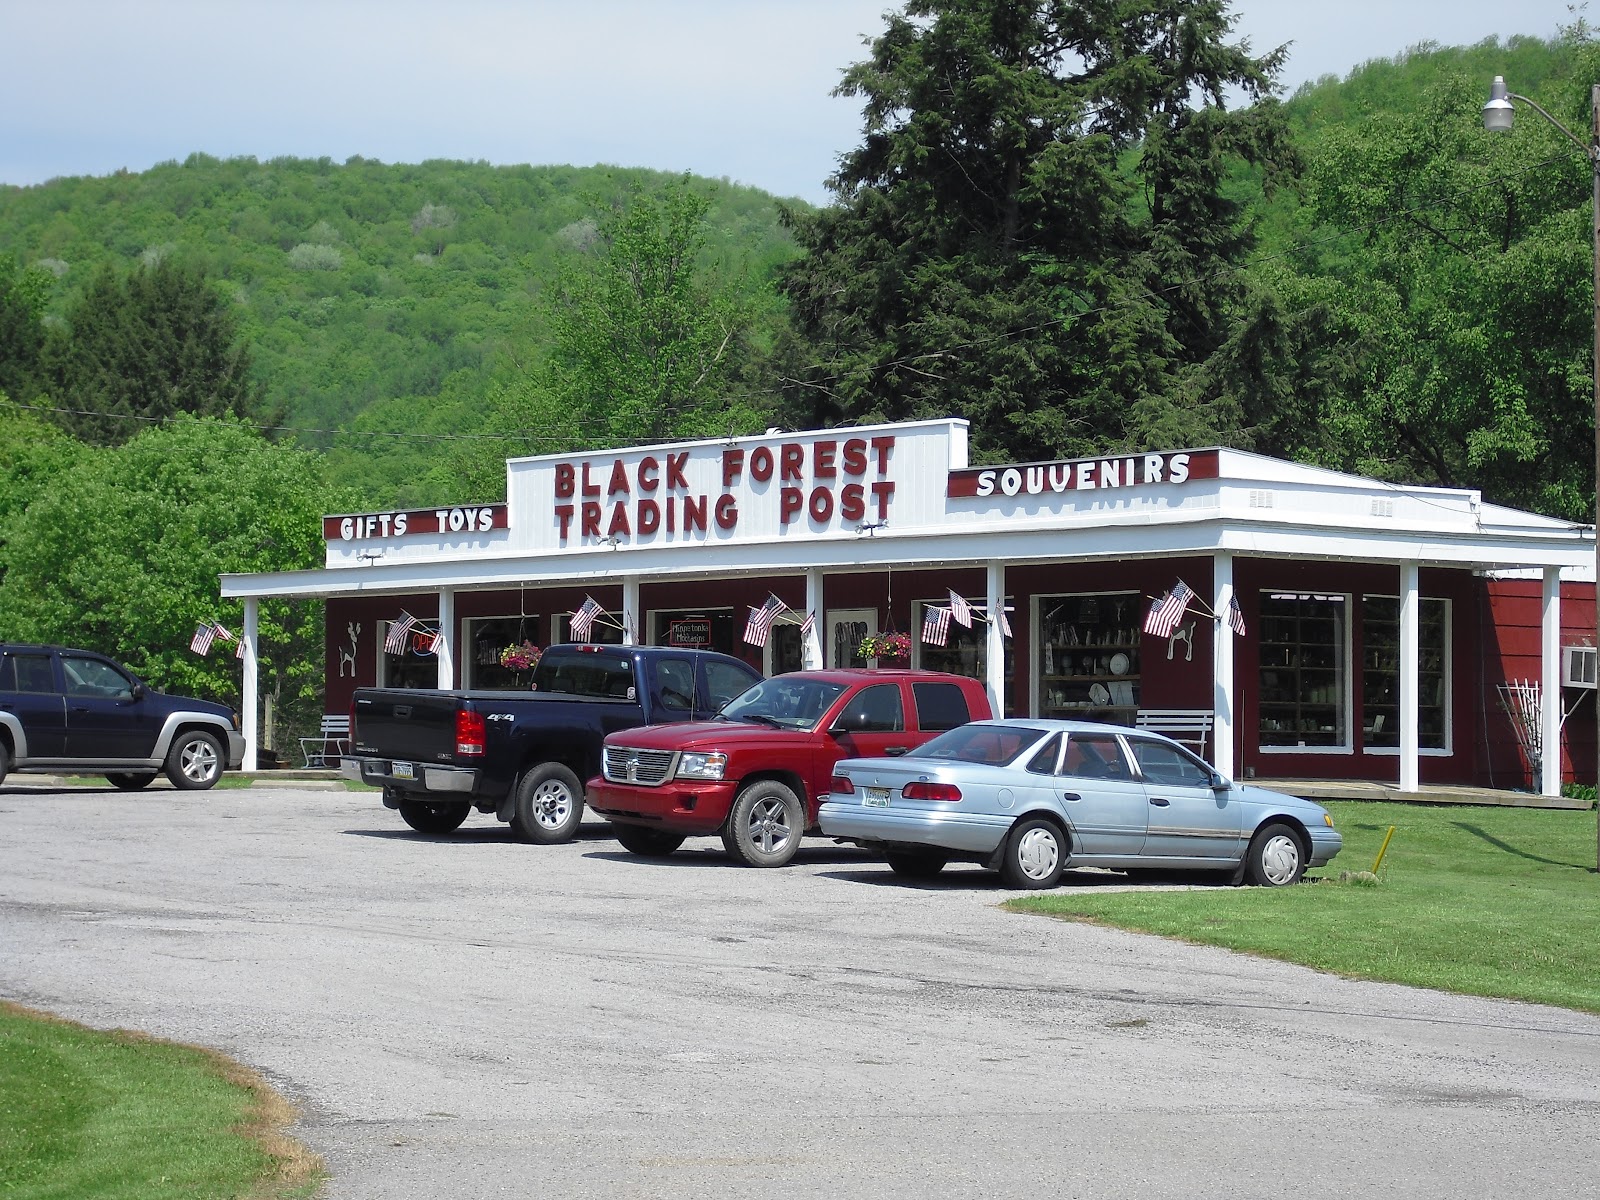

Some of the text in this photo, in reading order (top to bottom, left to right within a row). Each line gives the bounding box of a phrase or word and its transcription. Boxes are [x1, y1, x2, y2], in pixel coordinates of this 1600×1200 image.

[555, 436, 895, 498] BLACK FOREST
[976, 454, 1190, 497] SOUVENIRS
[340, 507, 493, 541] GIFTS TOYS
[555, 481, 895, 540] TRADING POST
[413, 633, 436, 651] OPE
